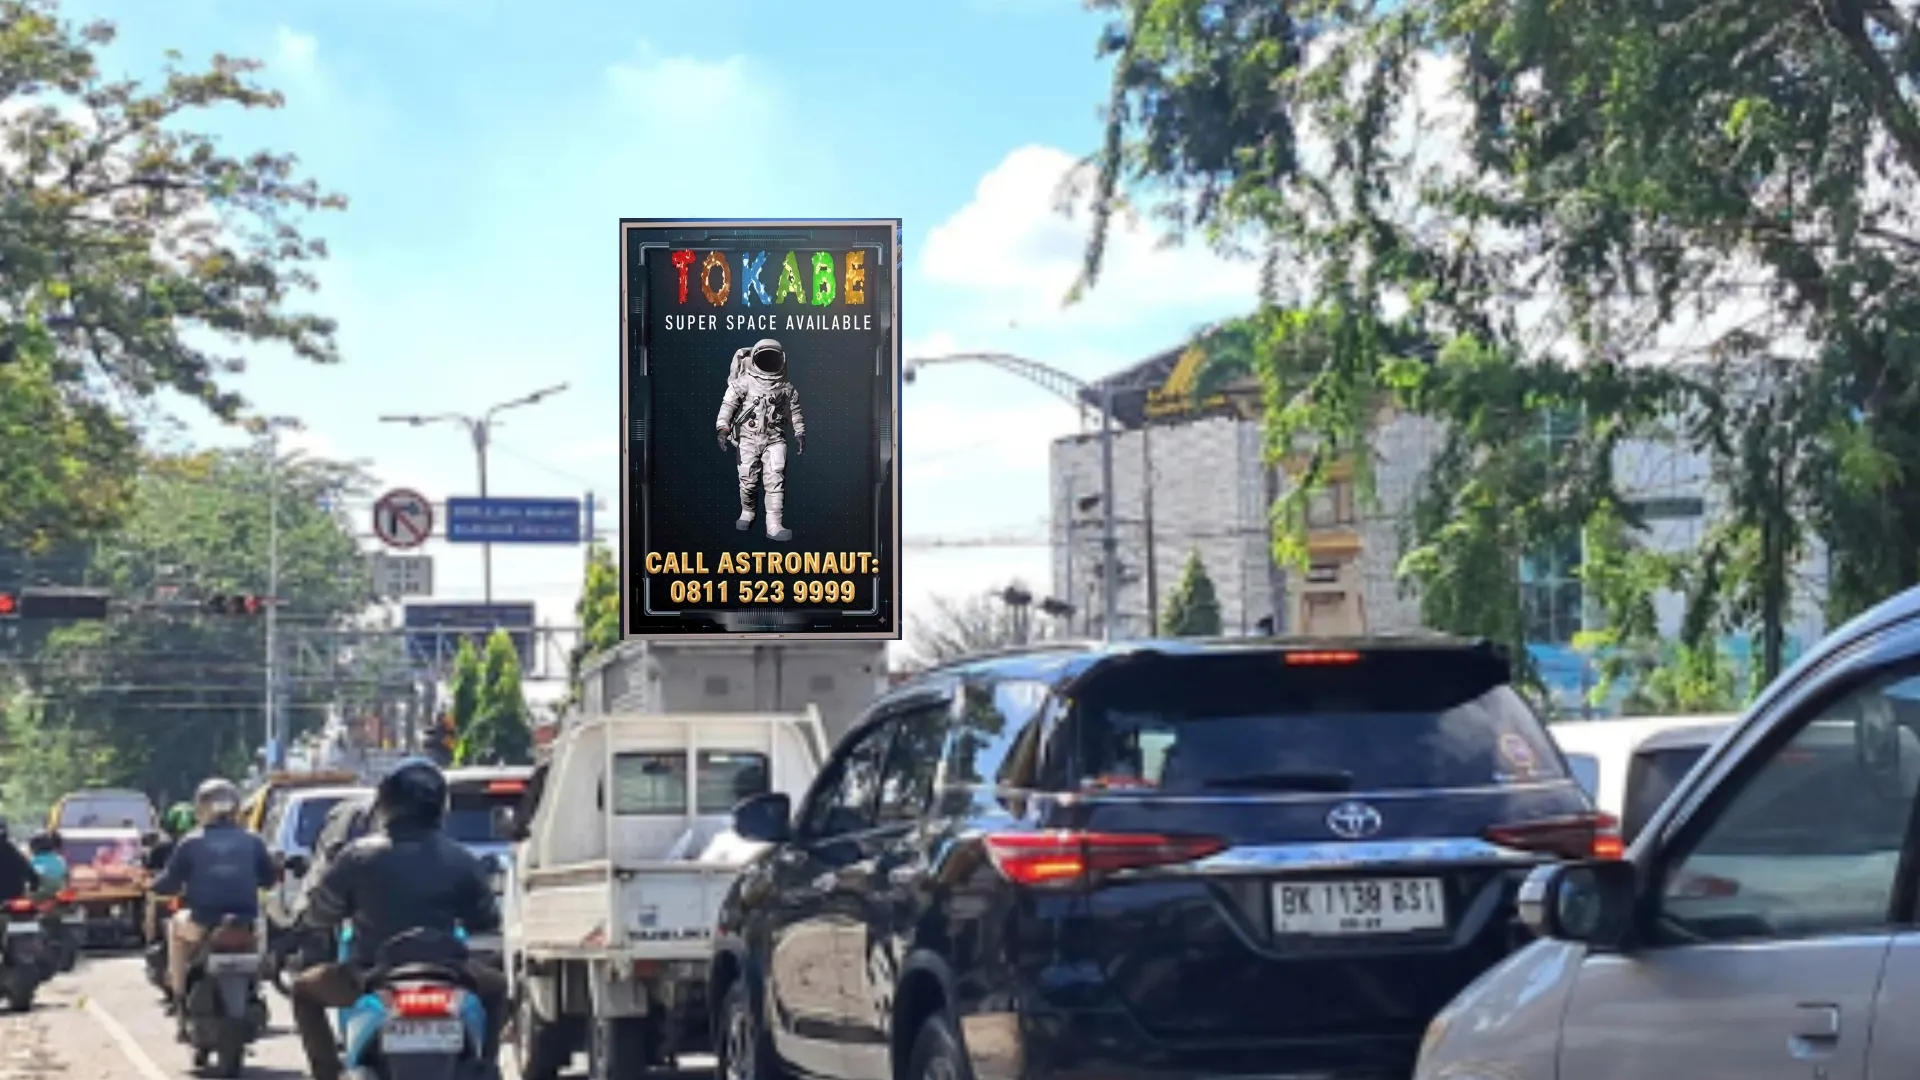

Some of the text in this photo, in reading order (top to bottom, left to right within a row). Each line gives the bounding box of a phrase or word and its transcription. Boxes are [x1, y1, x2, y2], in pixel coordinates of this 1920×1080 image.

[671, 248, 865, 307] TOKABE
[665, 315, 872, 330] SUPER SPACE AVAILABLE
[645, 551, 880, 574] CALL ASTRONAUT:
[670, 580, 856, 604] 0811 523 9999
[1281, 886, 1313, 914] BK
